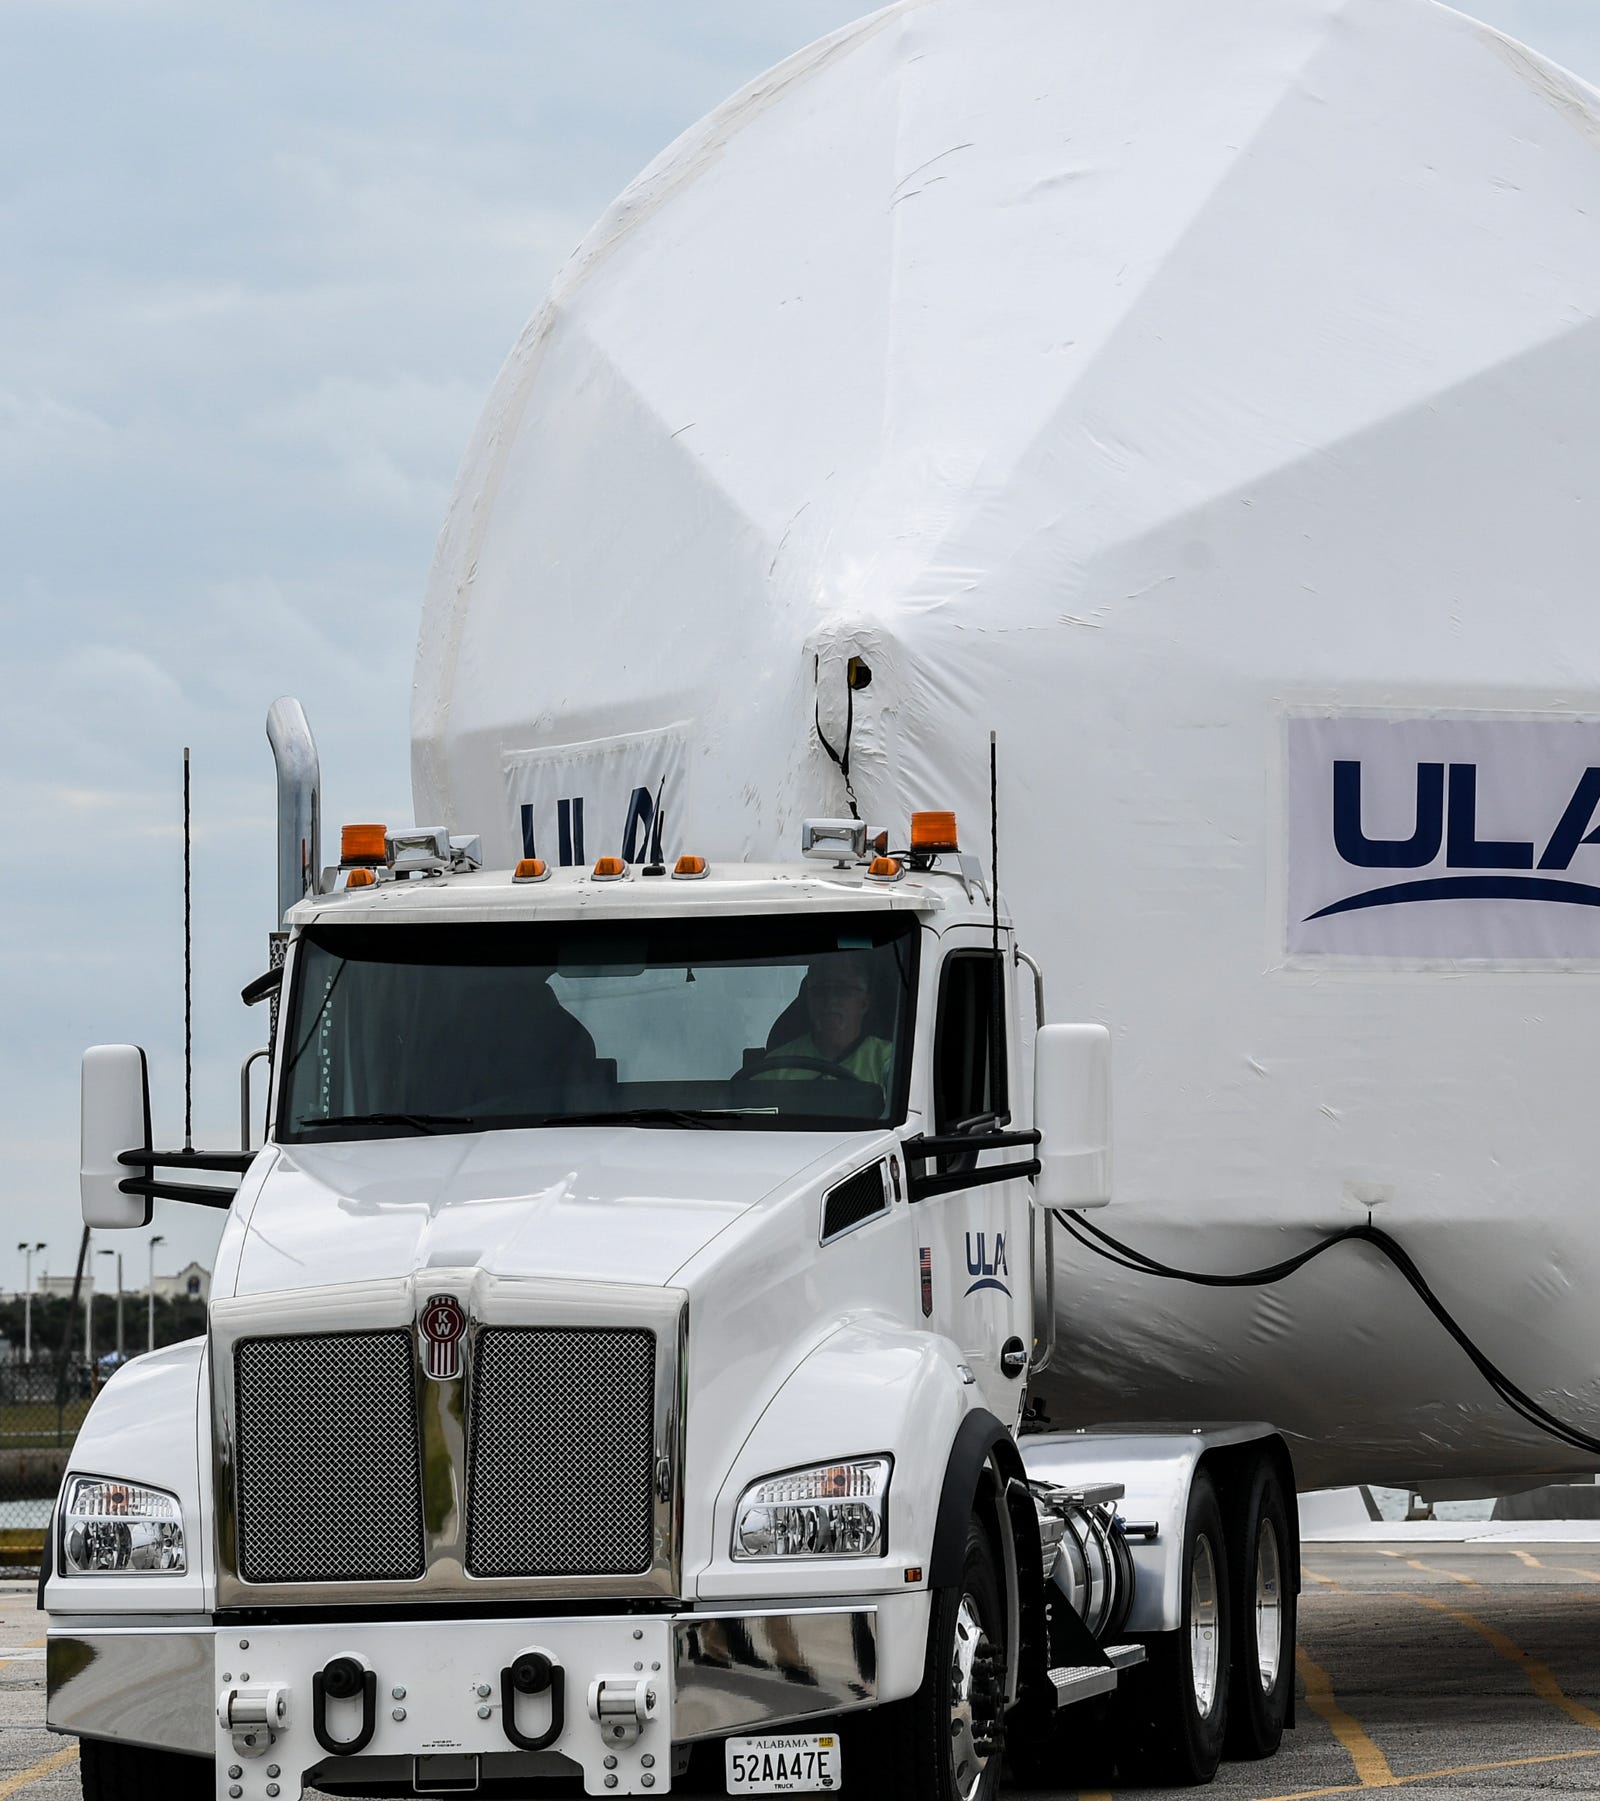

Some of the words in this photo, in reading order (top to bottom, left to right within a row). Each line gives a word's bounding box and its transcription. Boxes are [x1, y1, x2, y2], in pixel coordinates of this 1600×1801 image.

[965, 1230, 1008, 1276] ULA
[438, 1310, 450, 1323] K
[434, 1322, 452, 1336] W
[755, 1739, 809, 1750] ALABAMA
[732, 1751, 831, 1783] 52AA47E
[773, 1782, 794, 1790] TRUCK
